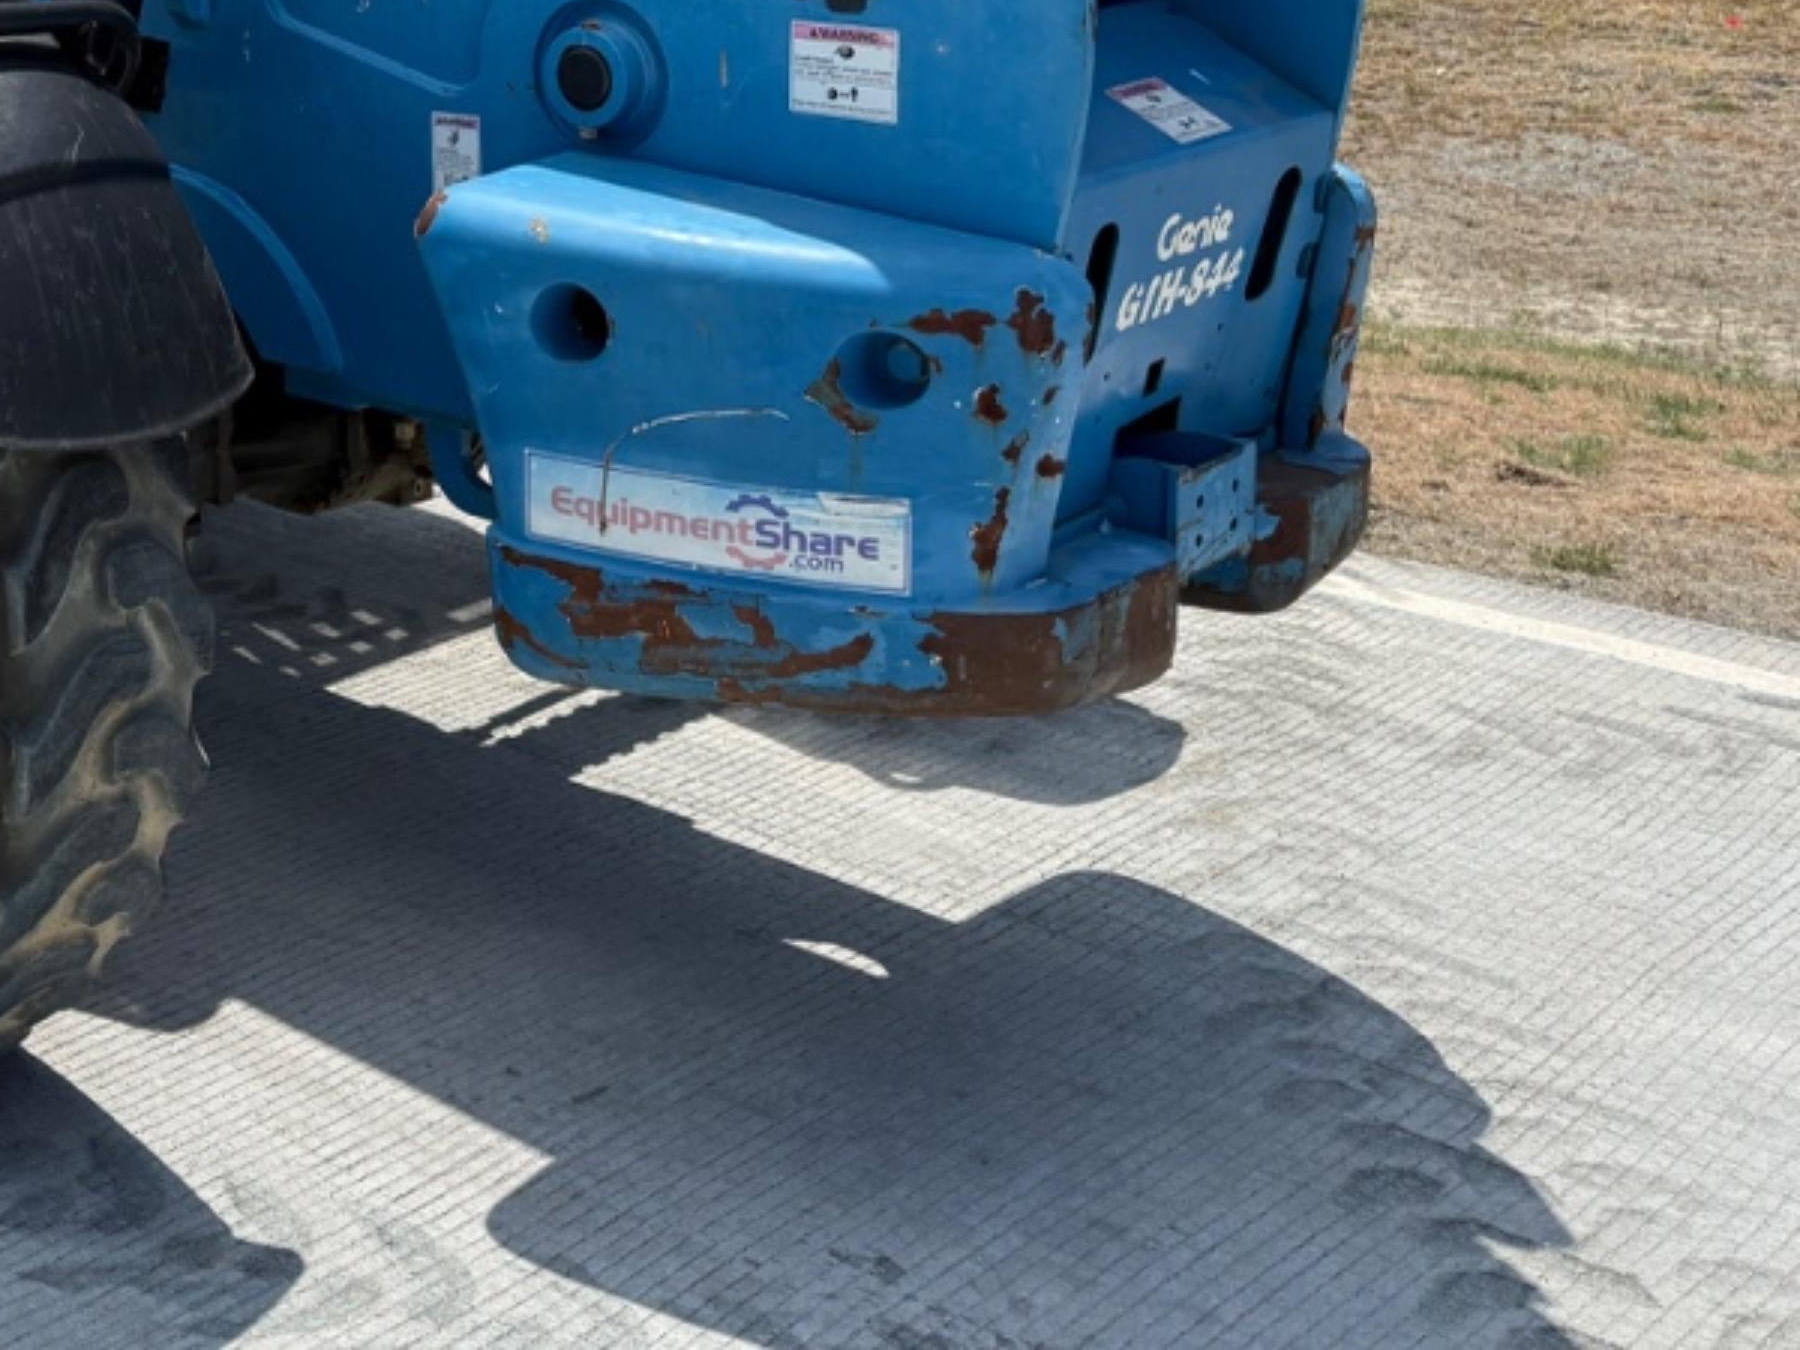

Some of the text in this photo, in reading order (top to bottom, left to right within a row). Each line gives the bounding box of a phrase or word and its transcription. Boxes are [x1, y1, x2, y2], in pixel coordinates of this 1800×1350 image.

[1157, 203, 1234, 262] Genie
[551, 486, 880, 561] EquipmentShare
[789, 554, 844, 572] .com
